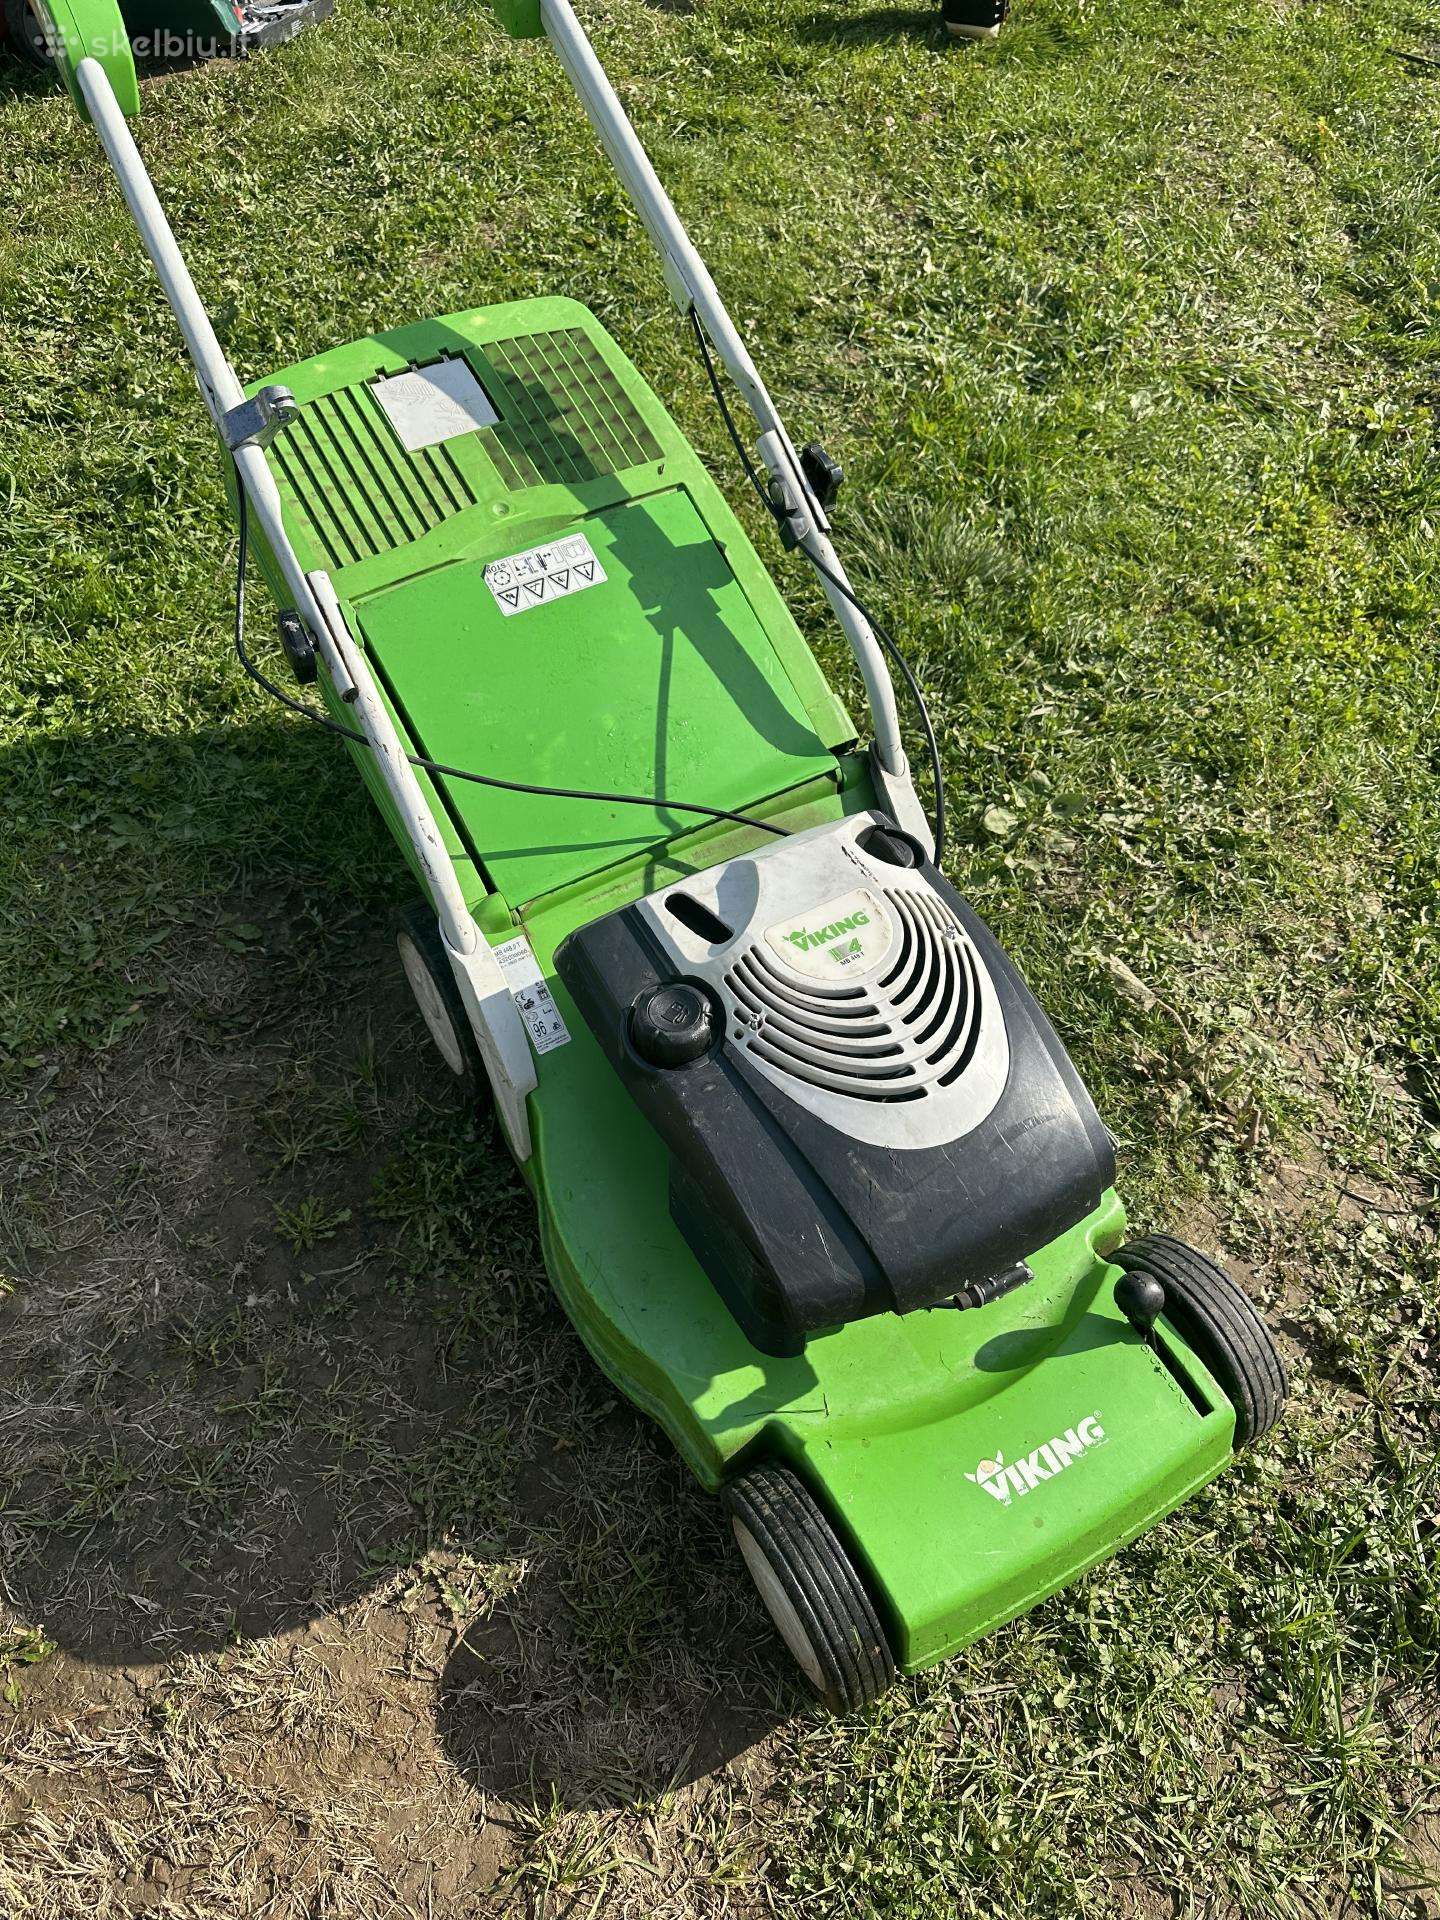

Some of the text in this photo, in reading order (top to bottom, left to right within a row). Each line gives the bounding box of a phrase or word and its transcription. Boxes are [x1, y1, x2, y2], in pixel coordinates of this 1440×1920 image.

[791, 911, 870, 952] VIKING
[532, 1020, 547, 1037] 96
[980, 1415, 1109, 1507] VIKING
